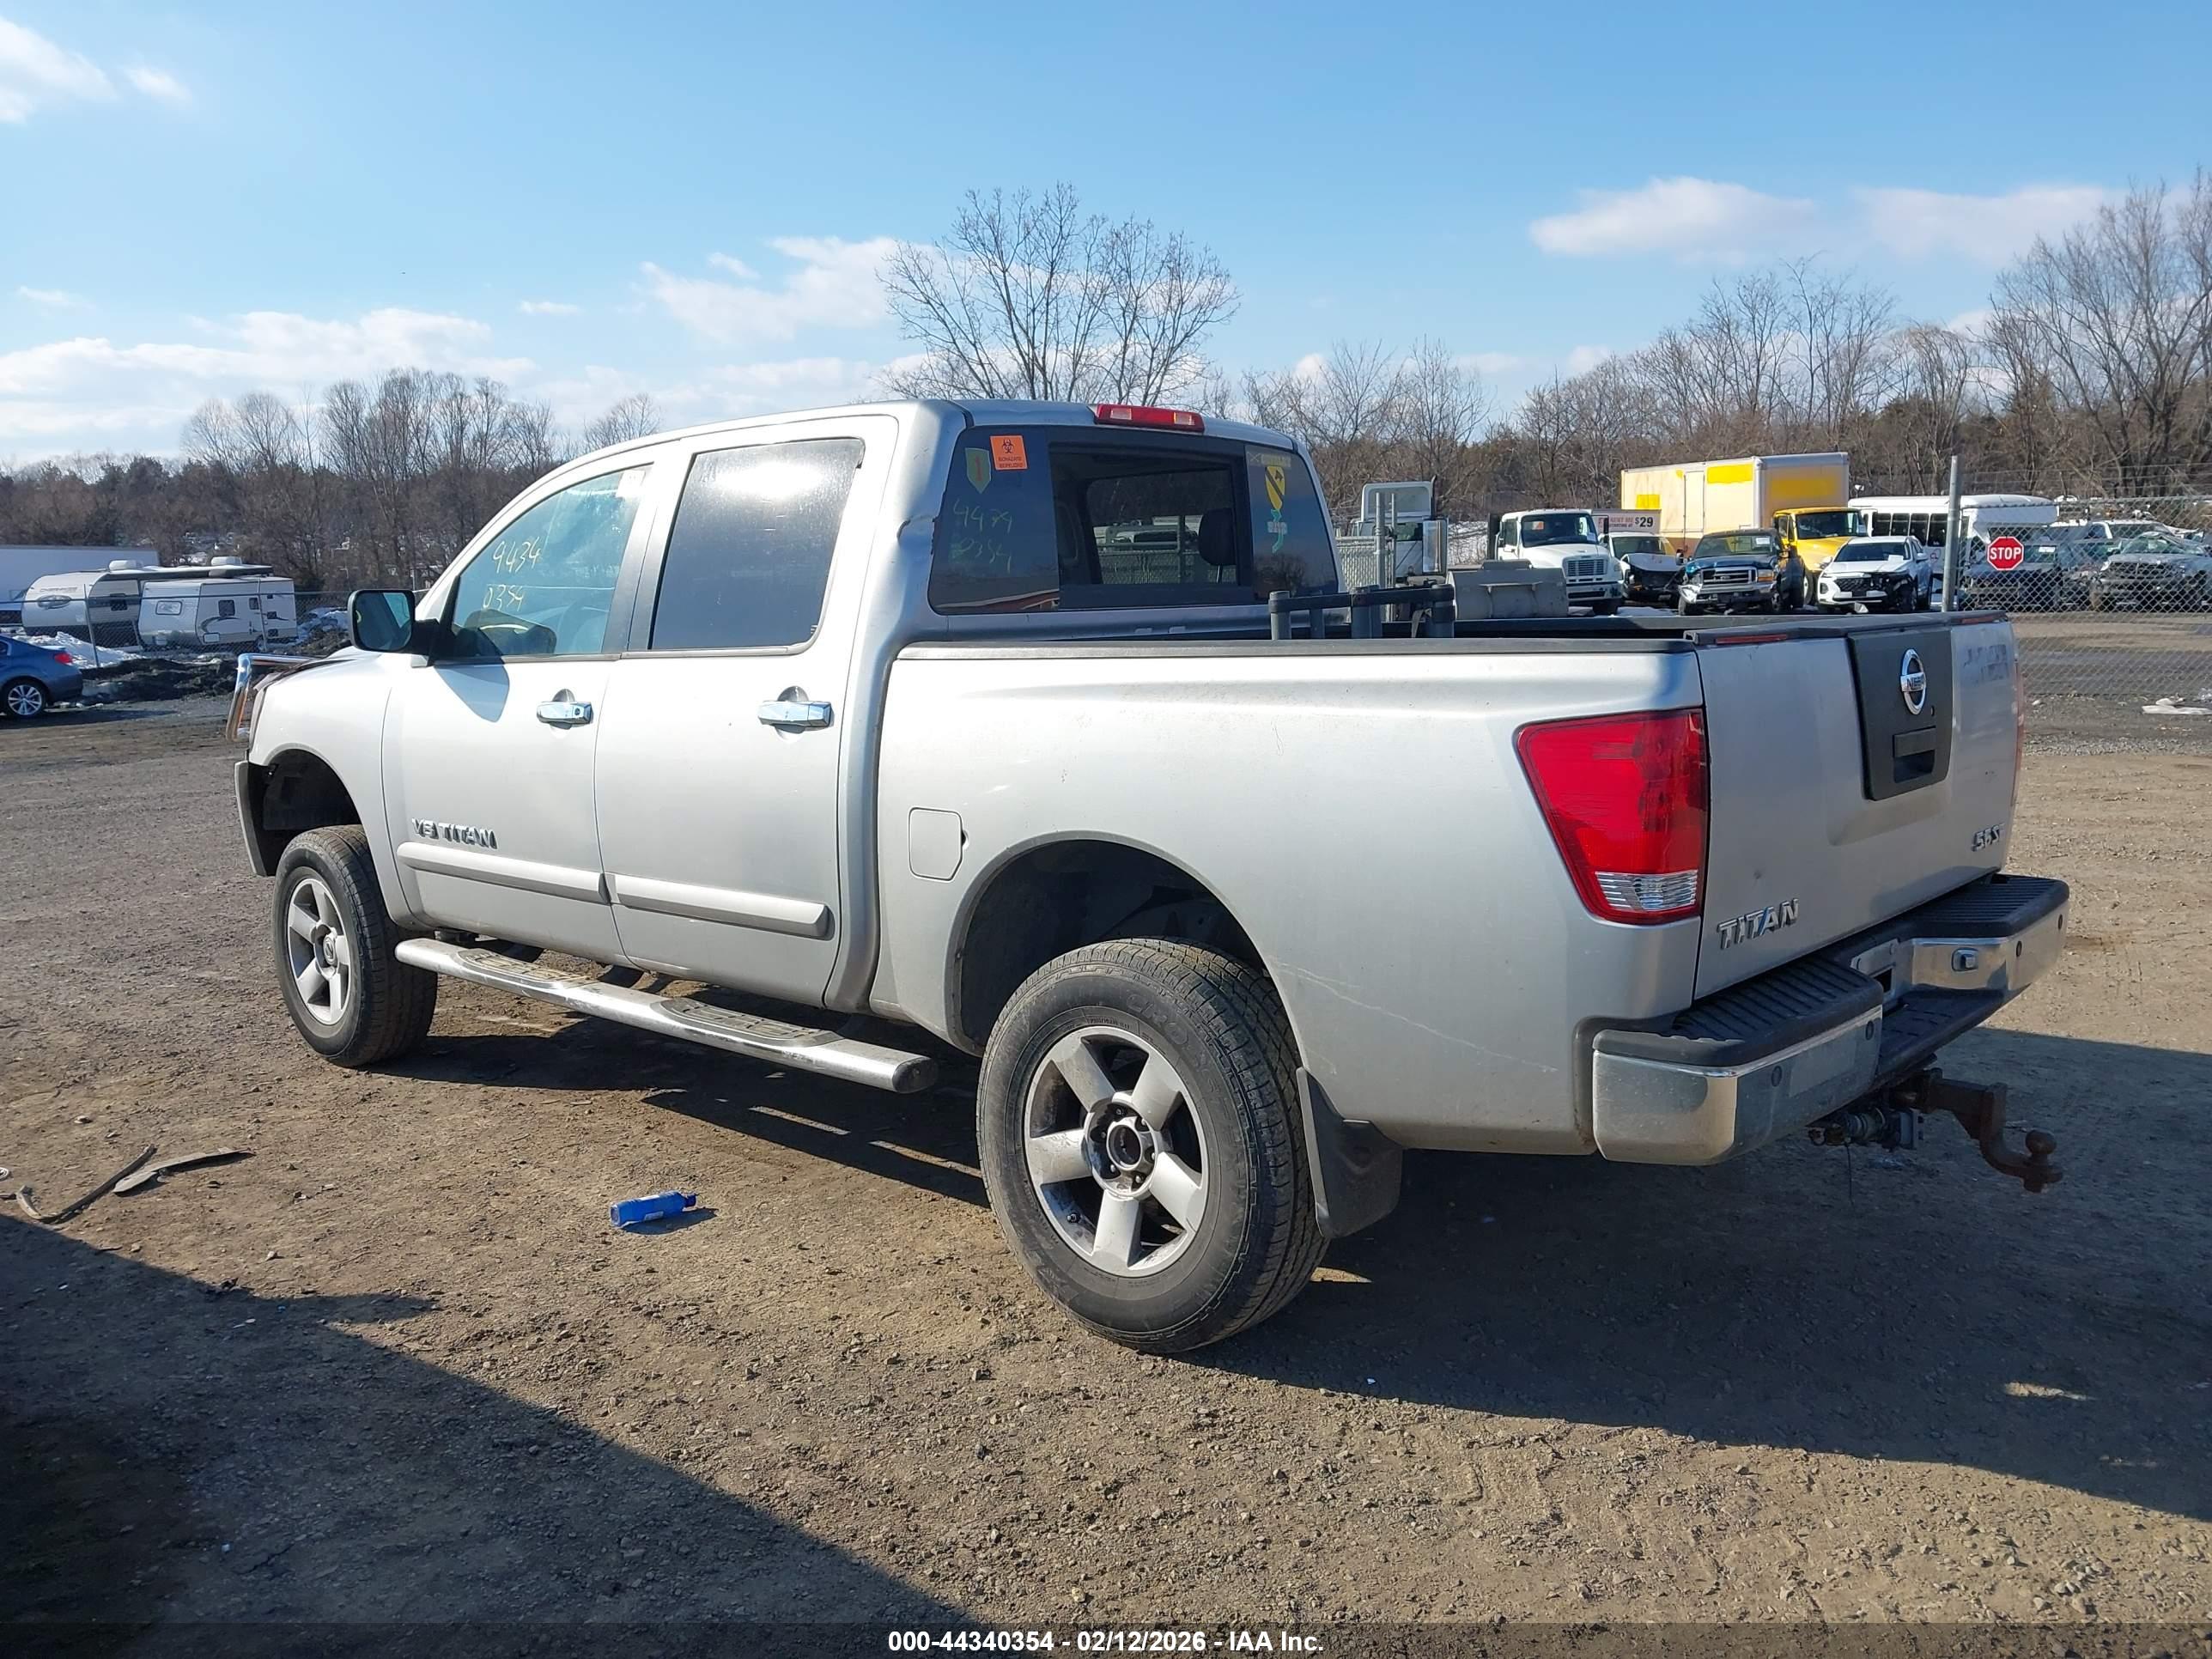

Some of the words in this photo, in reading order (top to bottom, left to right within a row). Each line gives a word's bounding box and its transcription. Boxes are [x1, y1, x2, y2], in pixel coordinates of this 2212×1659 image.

[1634, 516, 1654, 528] $29
[1990, 547, 2022, 560] STOP
[439, 823, 497, 849] TITAN
[1717, 897, 1799, 950] TITAN
